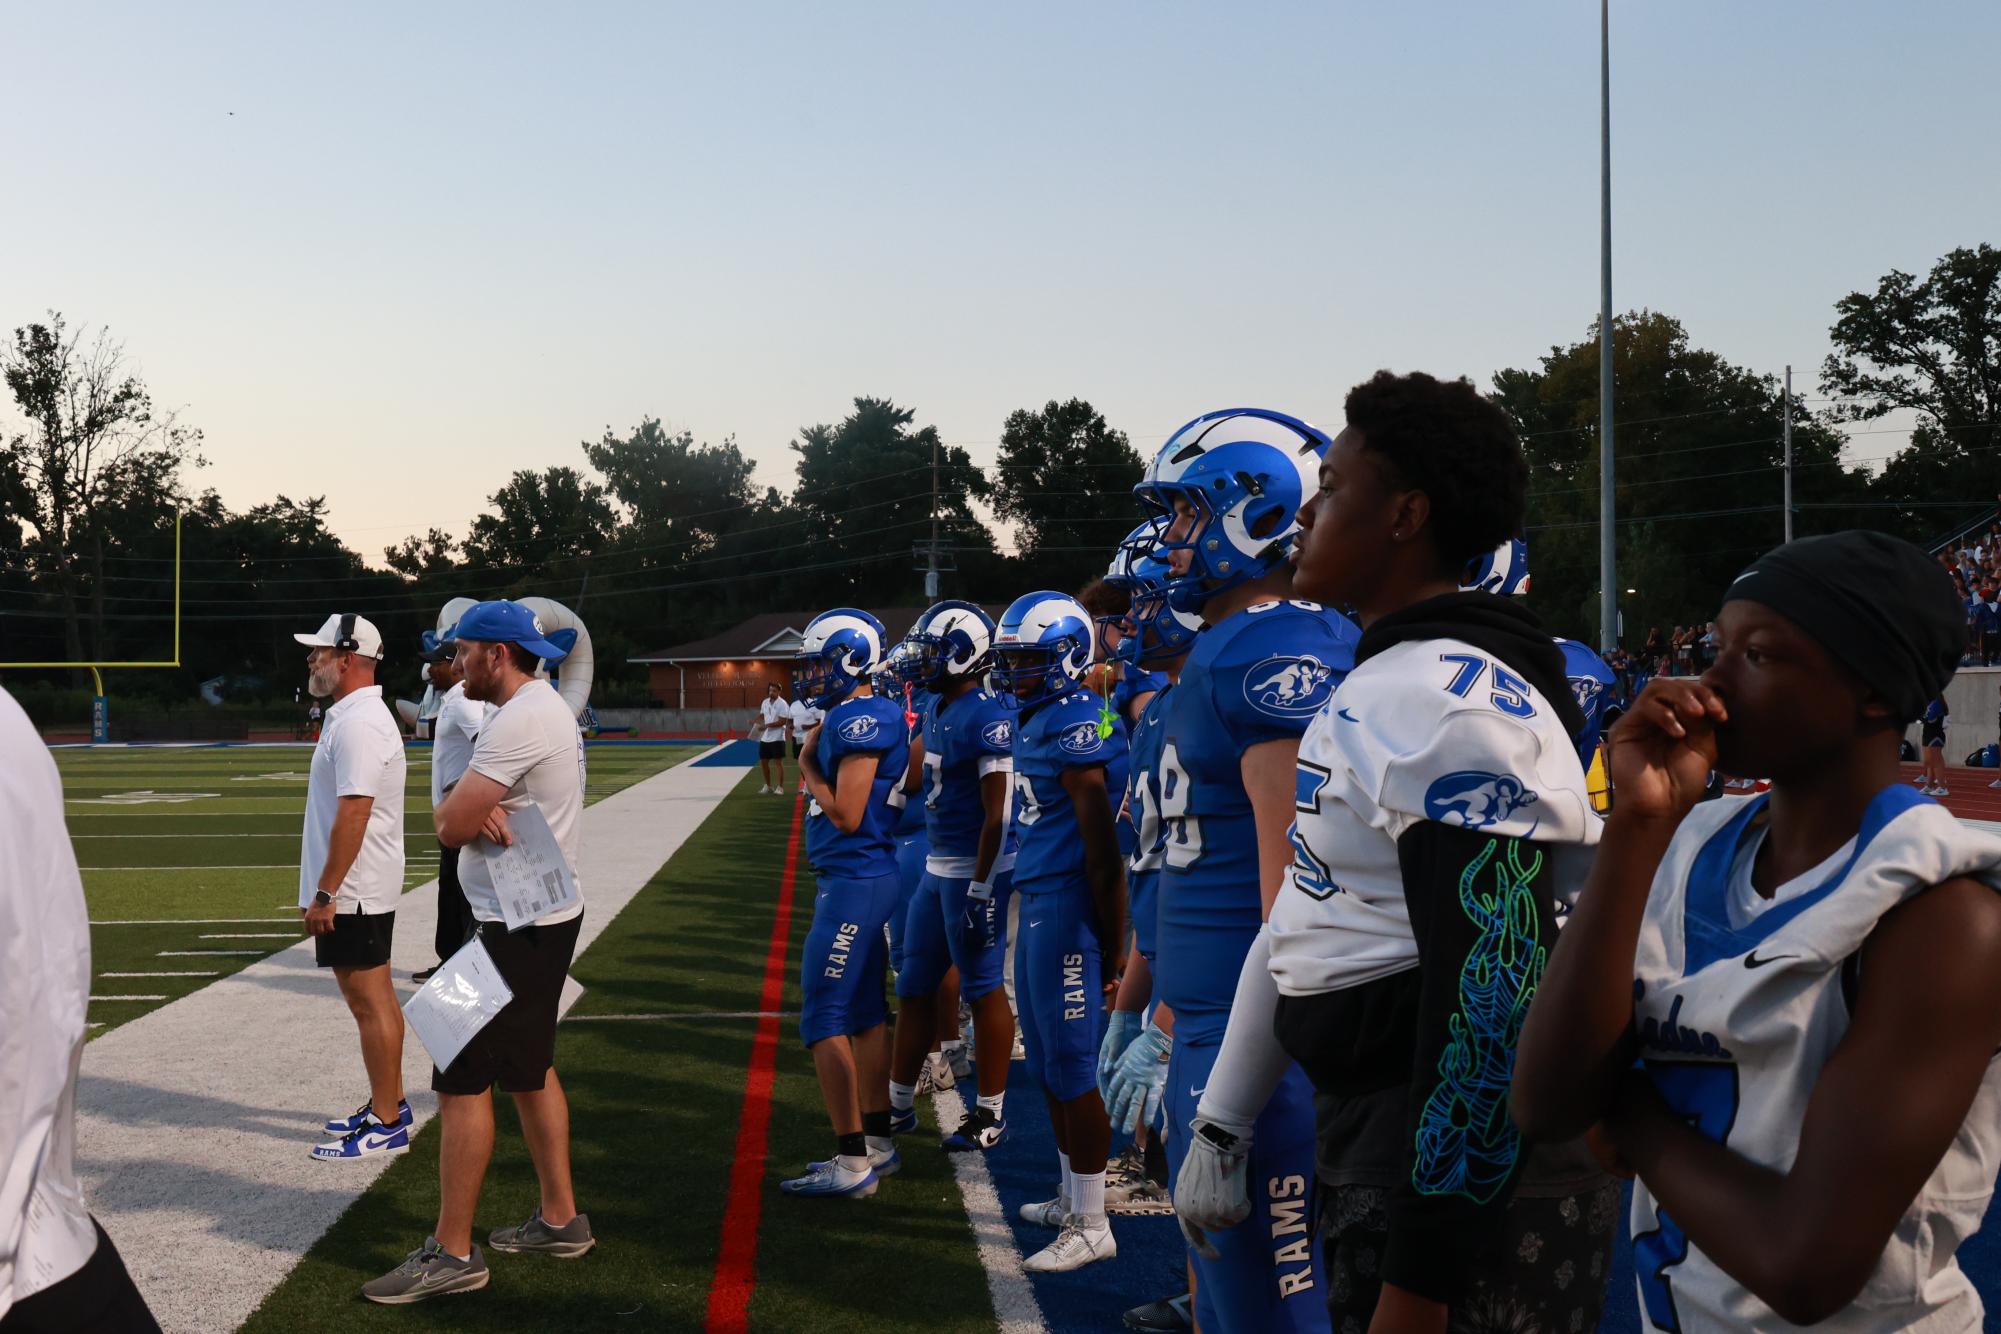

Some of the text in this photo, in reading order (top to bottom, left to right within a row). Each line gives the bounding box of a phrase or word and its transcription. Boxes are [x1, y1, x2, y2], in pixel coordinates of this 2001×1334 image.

[1440, 653, 1537, 719] 75
[825, 922, 859, 979] RAMS
[1063, 953, 1086, 1021] RAMS
[319, 1149, 341, 1157] RAMS
[1268, 1174, 1314, 1301] RAMS
